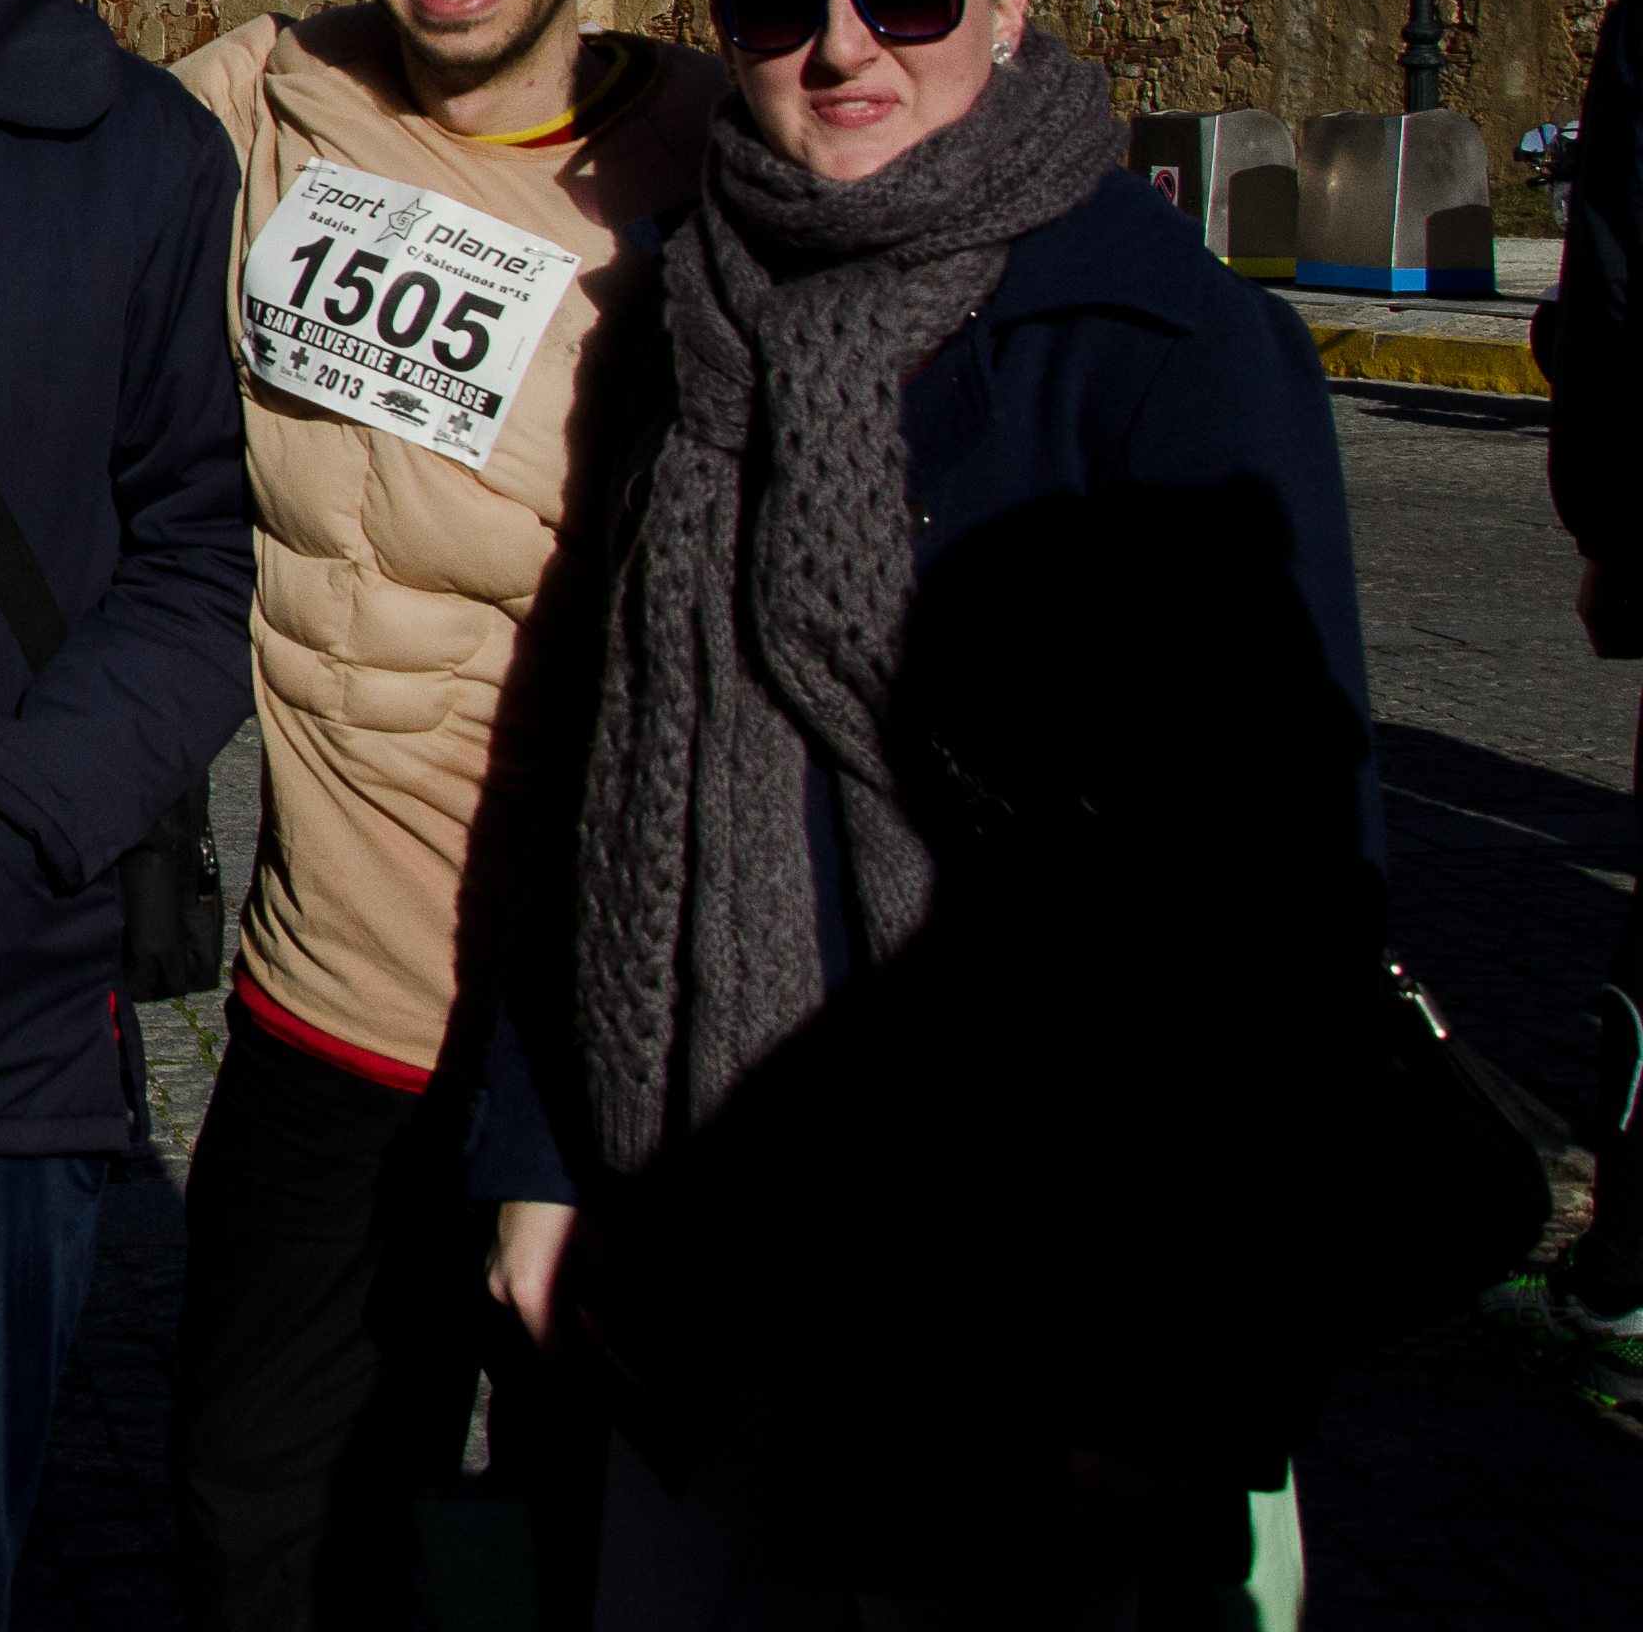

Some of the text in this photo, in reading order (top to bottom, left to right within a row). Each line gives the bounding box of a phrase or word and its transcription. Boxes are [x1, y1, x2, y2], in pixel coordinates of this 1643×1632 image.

[308, 210, 357, 235] Badajoz
[288, 235, 506, 373] 1505
[263, 306, 298, 335] SAN
[299, 320, 394, 374] SILVESTRE
[395, 357, 489, 412] PACENSE
[314, 363, 364, 400] 2013
